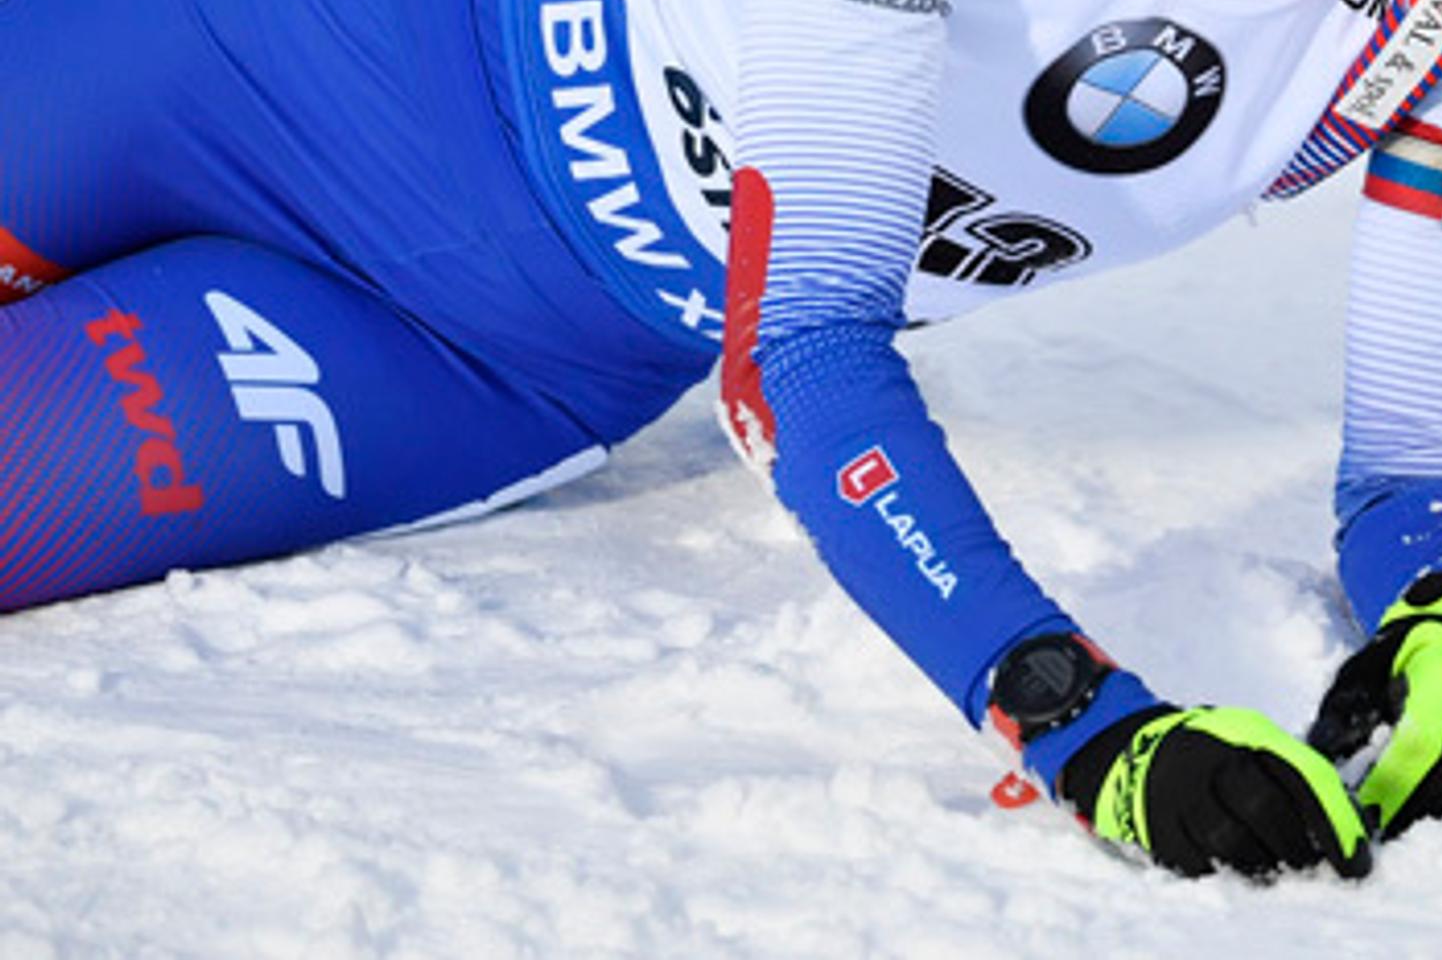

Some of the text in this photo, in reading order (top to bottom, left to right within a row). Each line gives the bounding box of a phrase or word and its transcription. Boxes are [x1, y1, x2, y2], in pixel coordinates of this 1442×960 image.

[1092, 25, 1221, 97] BMW
[1384, 50, 1416, 74] &
[84, 307, 204, 516] twd
[204, 289, 346, 500] 4F
[874, 491, 959, 600] LAPUA
